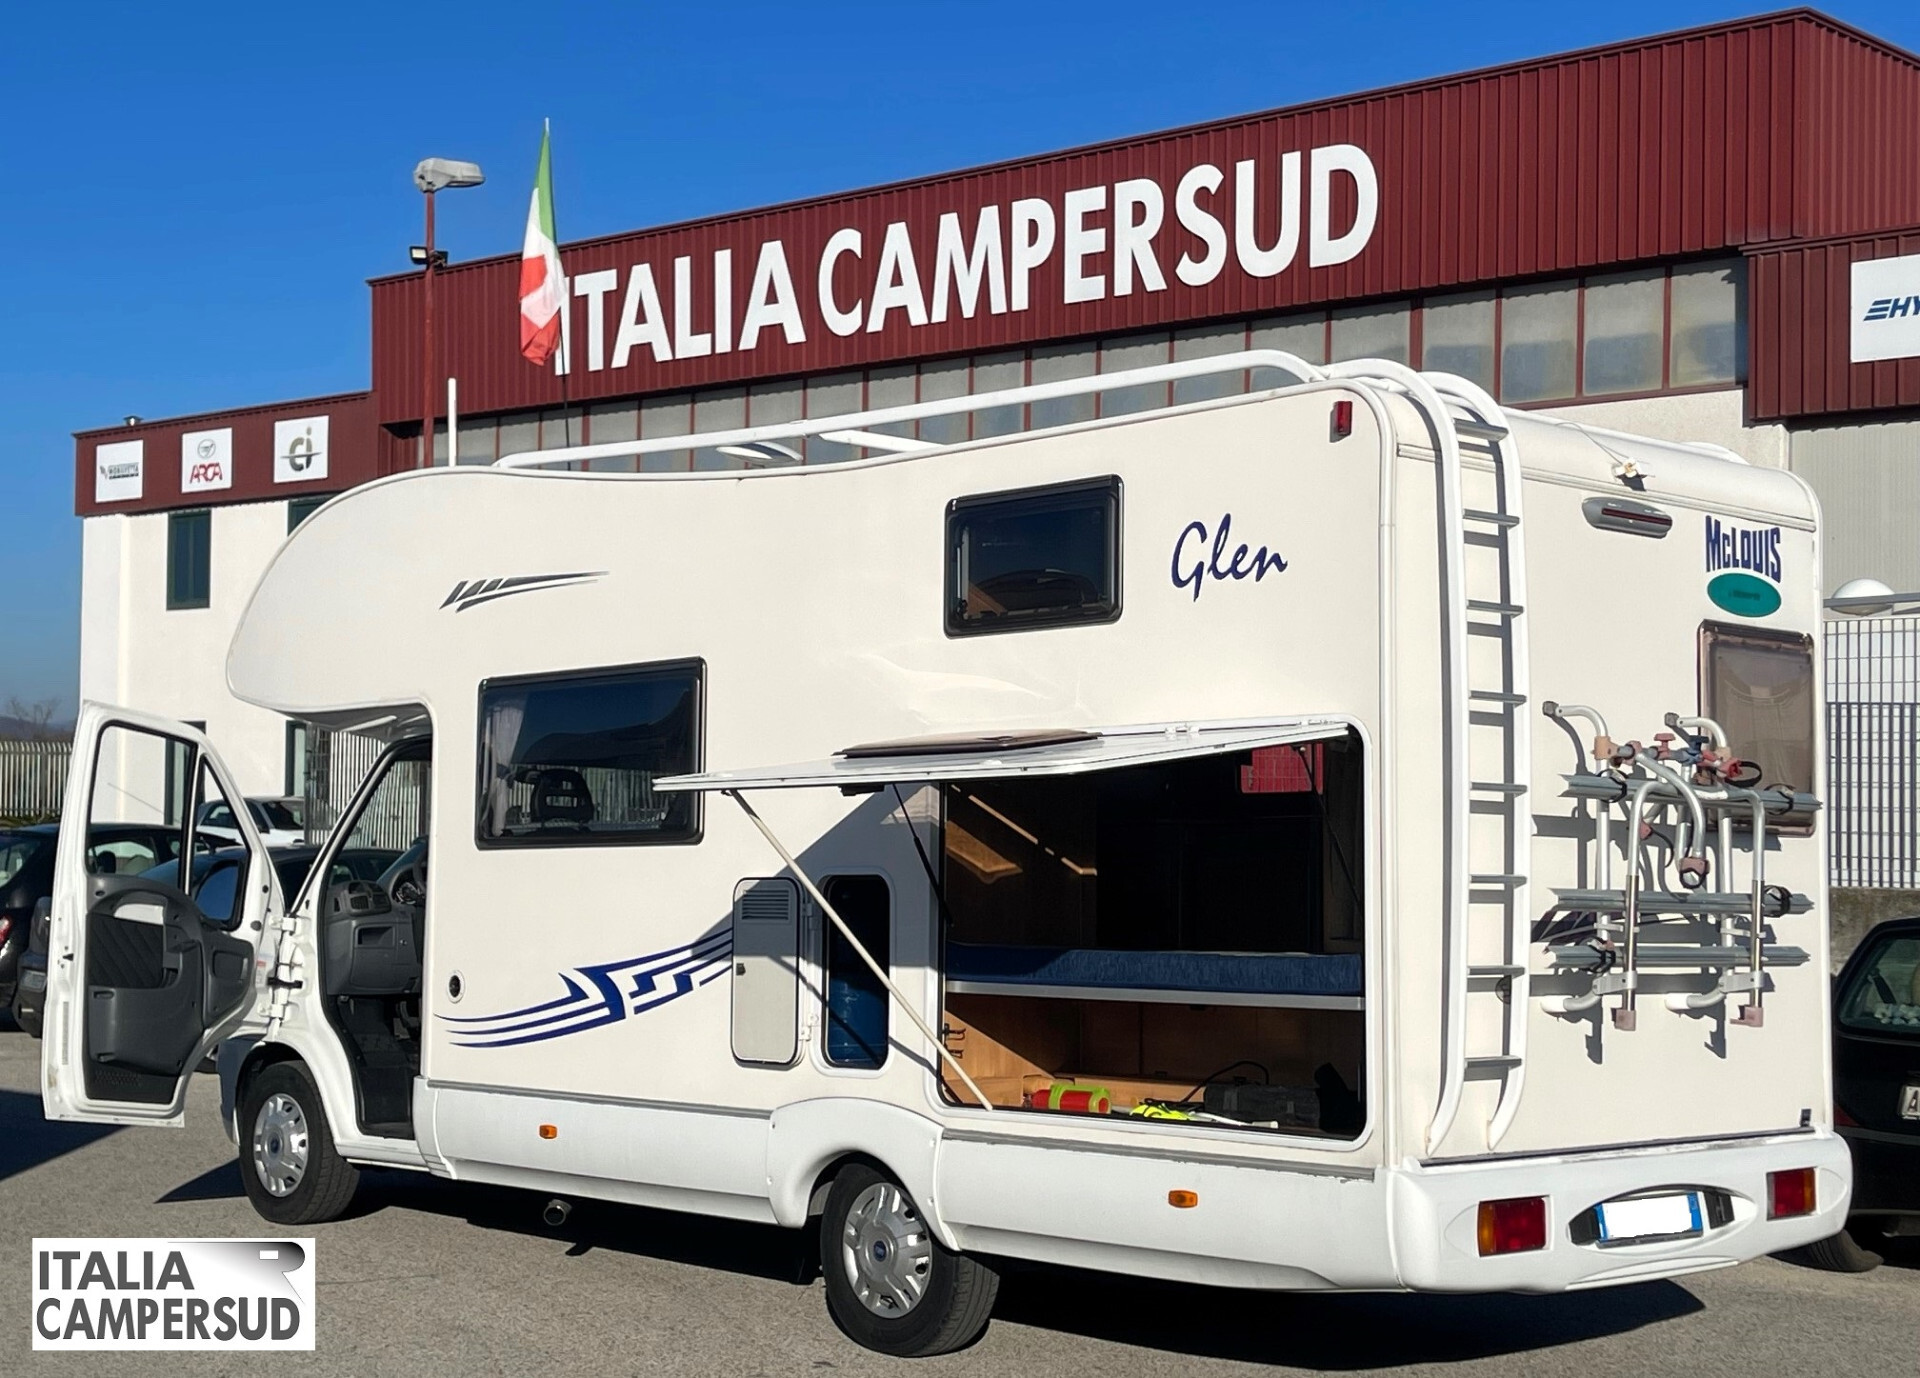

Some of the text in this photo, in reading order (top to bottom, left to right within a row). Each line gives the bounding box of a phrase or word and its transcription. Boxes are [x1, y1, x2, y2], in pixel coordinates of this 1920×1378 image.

[555, 143, 1379, 376] ITALIA CAMPERSUD
[190, 462, 223, 483] ARCA
[1171, 513, 1288, 602] Glen
